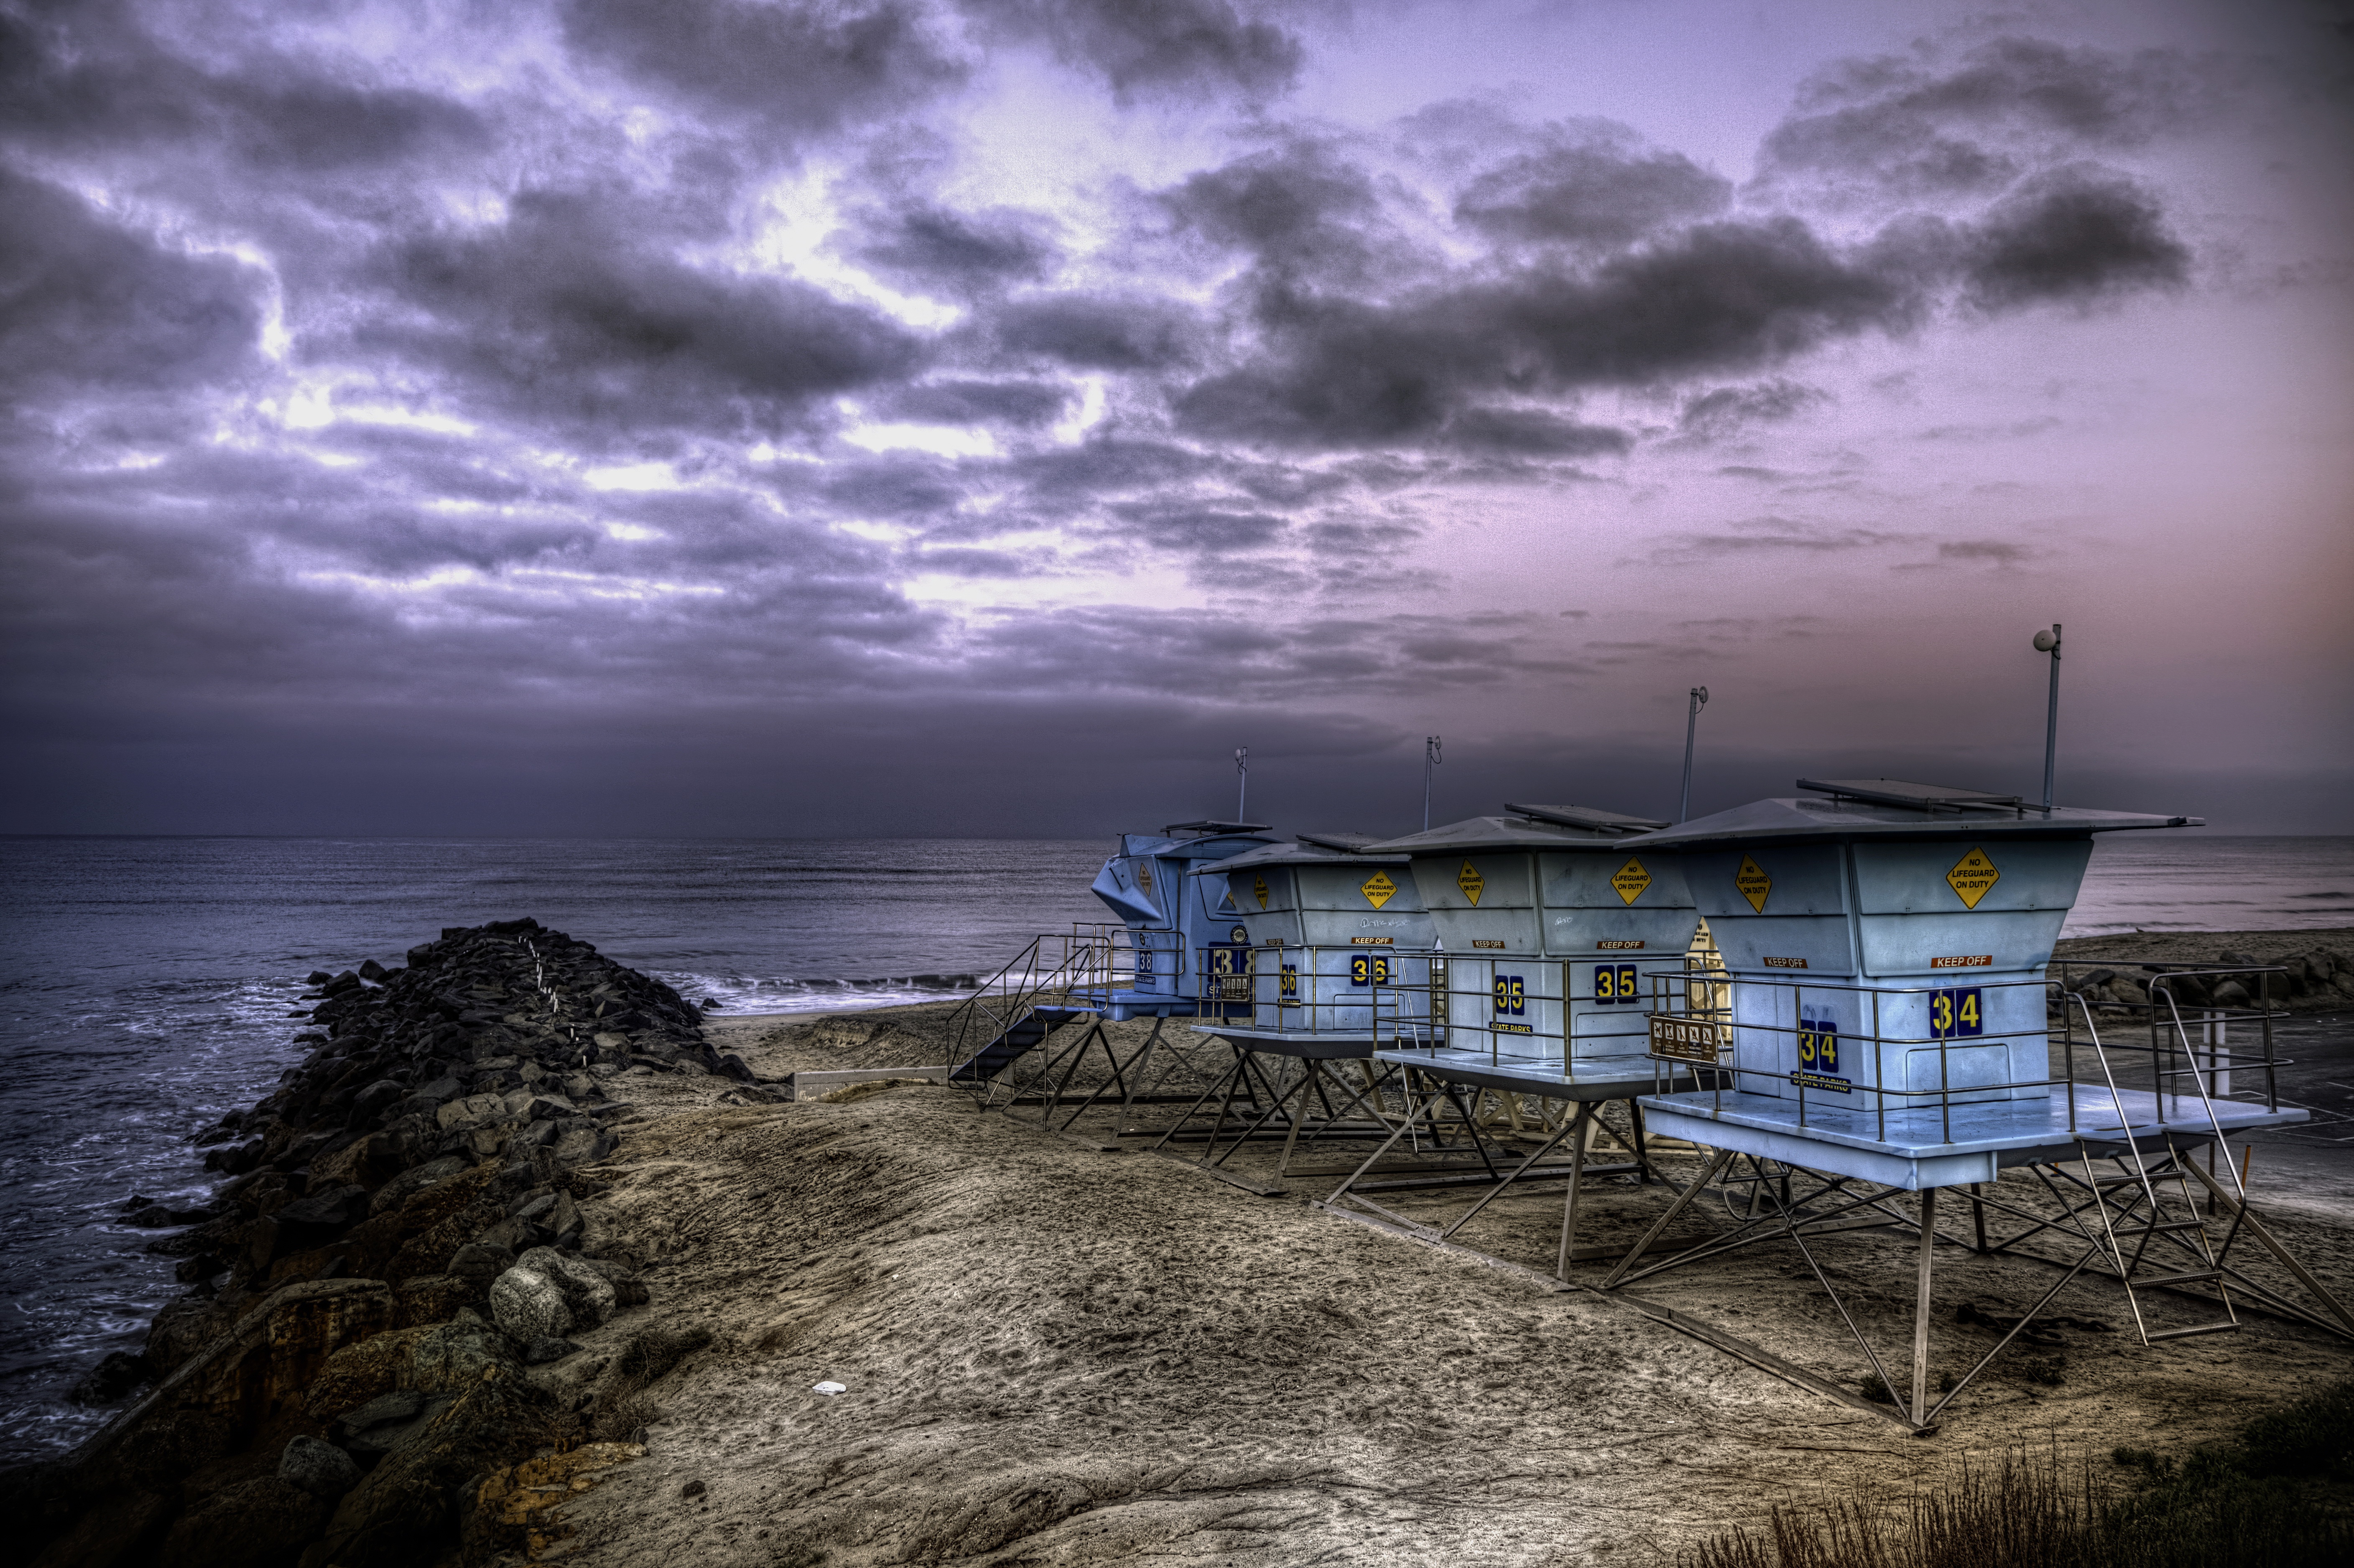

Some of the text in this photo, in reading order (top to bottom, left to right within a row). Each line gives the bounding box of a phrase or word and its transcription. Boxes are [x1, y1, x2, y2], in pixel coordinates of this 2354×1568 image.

[1140, 953, 1151, 970] 38
[1354, 960, 1386, 982] 36
[1767, 957, 1803, 967] KEEP OFF
[1937, 956, 1987, 967] KEEP OFF
[1282, 970, 1296, 991] 36
[1598, 971, 1634, 997] 35
[1497, 982, 1523, 1009] 35
[1933, 994, 1979, 1030] 34
[1801, 1028, 1836, 1064] 34
[1793, 1073, 1818, 1087] SATE
[1820, 1077, 1848, 1092] PARKS
